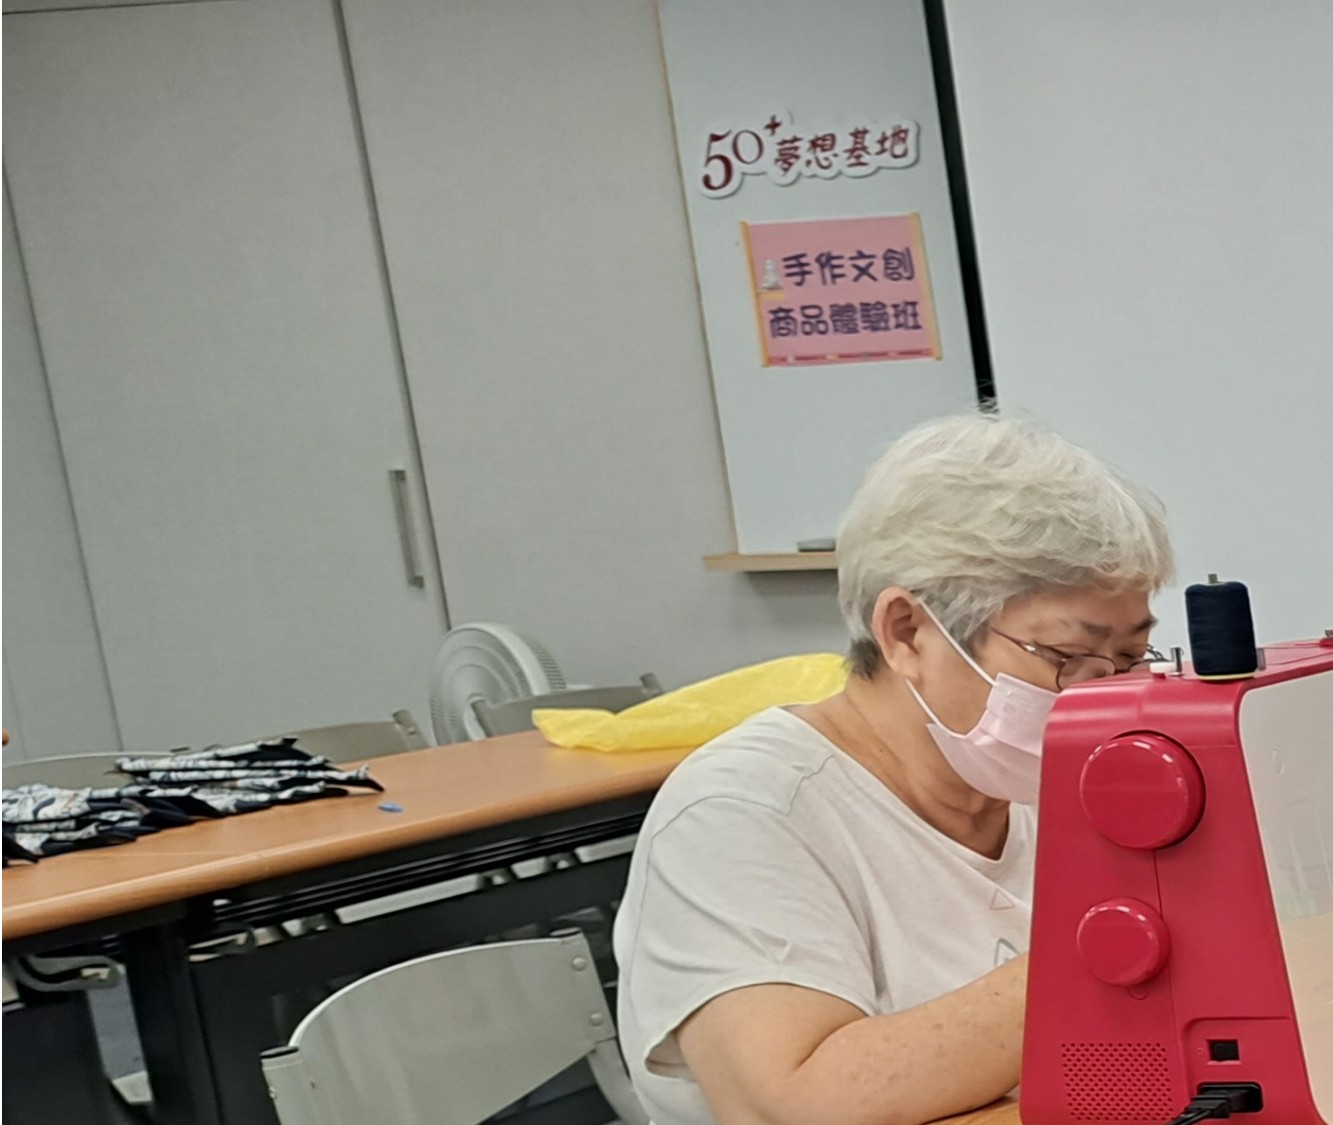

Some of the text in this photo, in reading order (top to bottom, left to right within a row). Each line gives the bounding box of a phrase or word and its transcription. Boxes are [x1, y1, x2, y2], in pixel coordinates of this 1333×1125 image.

[782, 247, 915, 287] 手作文創
[768, 301, 922, 338] 商品體驗班
